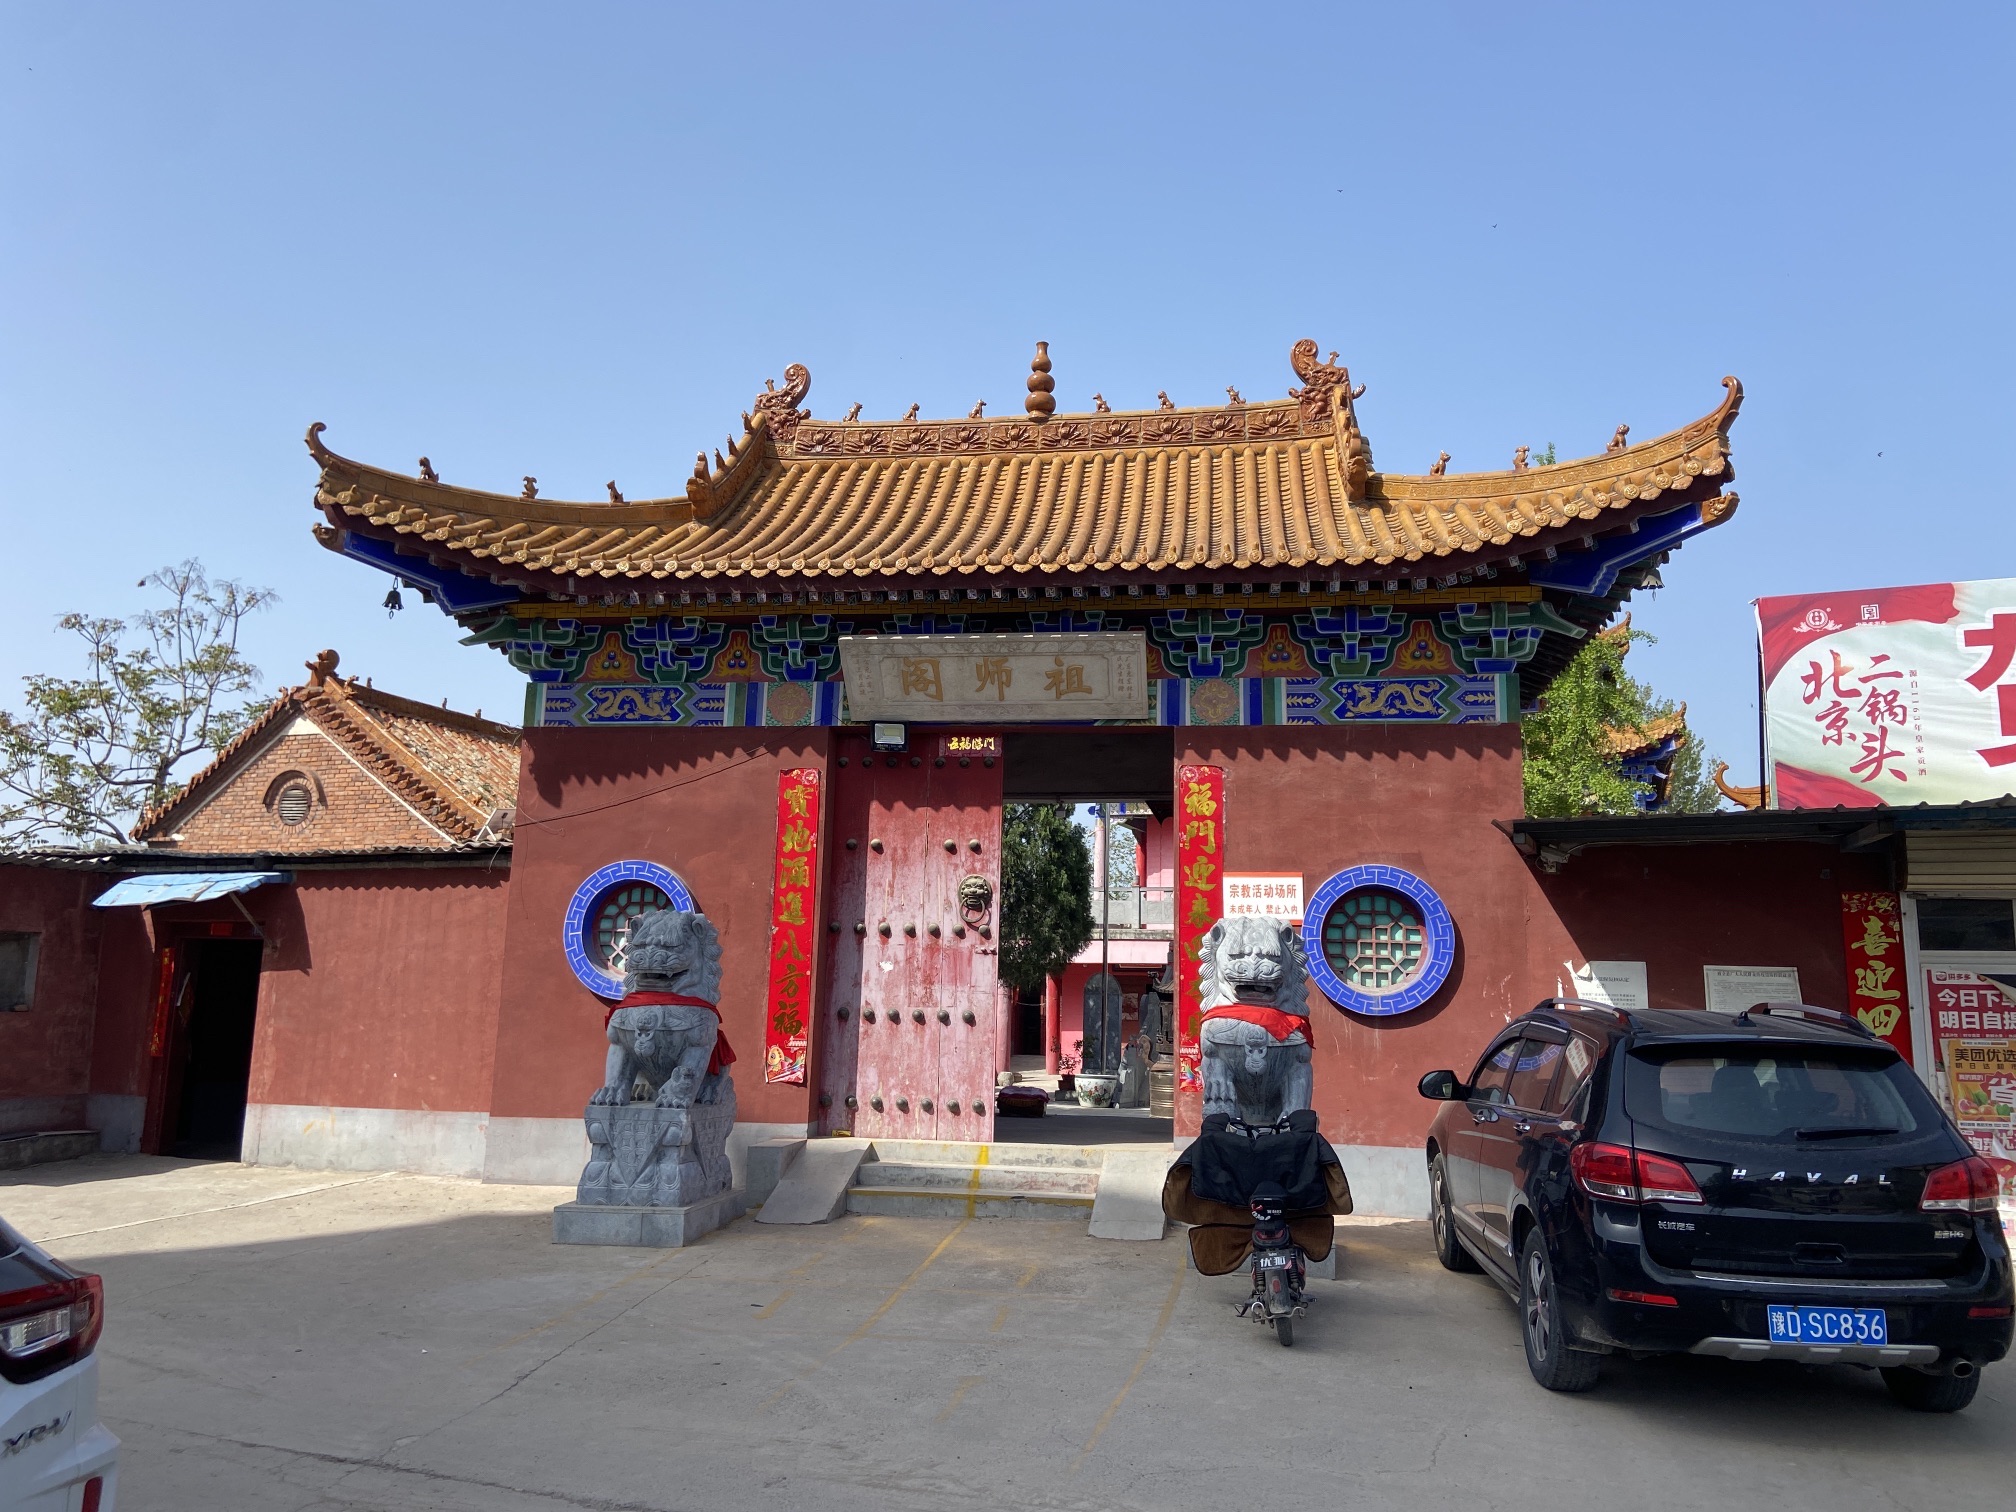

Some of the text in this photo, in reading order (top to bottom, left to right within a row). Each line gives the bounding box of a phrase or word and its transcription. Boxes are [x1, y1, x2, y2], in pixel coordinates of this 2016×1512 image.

[1800, 650, 1862, 746] 北京
[1849, 653, 1908, 783] 二锅头
[1229, 884, 1297, 899] 宗教活动场所
[1229, 904, 1298, 915] 未成年人 禁止入内
[1954, 1048, 2016, 1063] 美团优选
[1731, 1168, 1892, 1185] HAVAL
